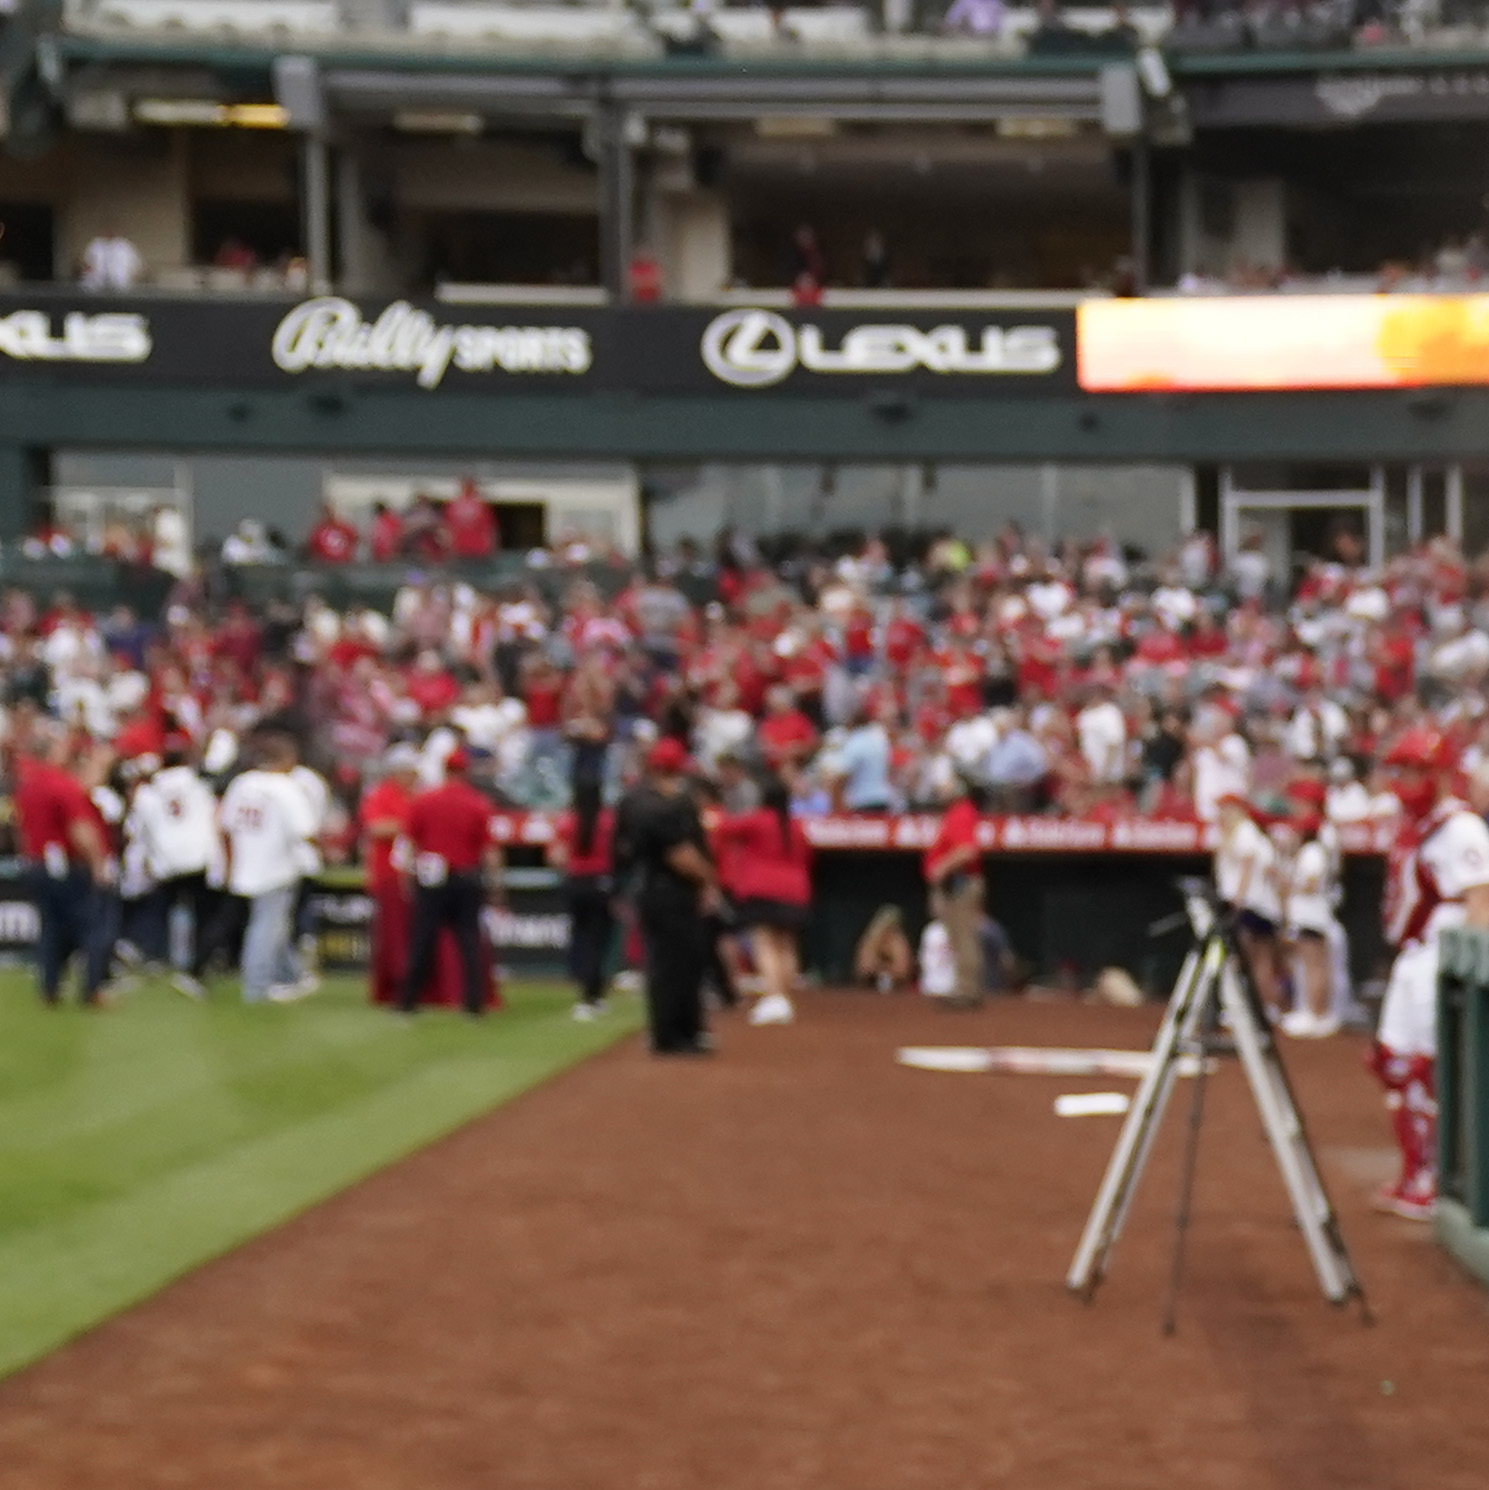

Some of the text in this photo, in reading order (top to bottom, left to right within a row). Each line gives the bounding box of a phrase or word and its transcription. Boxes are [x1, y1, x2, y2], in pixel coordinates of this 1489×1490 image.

[272, 296, 592, 390] Bally SPORTS
[800, 323, 1062, 374] LEXUS
